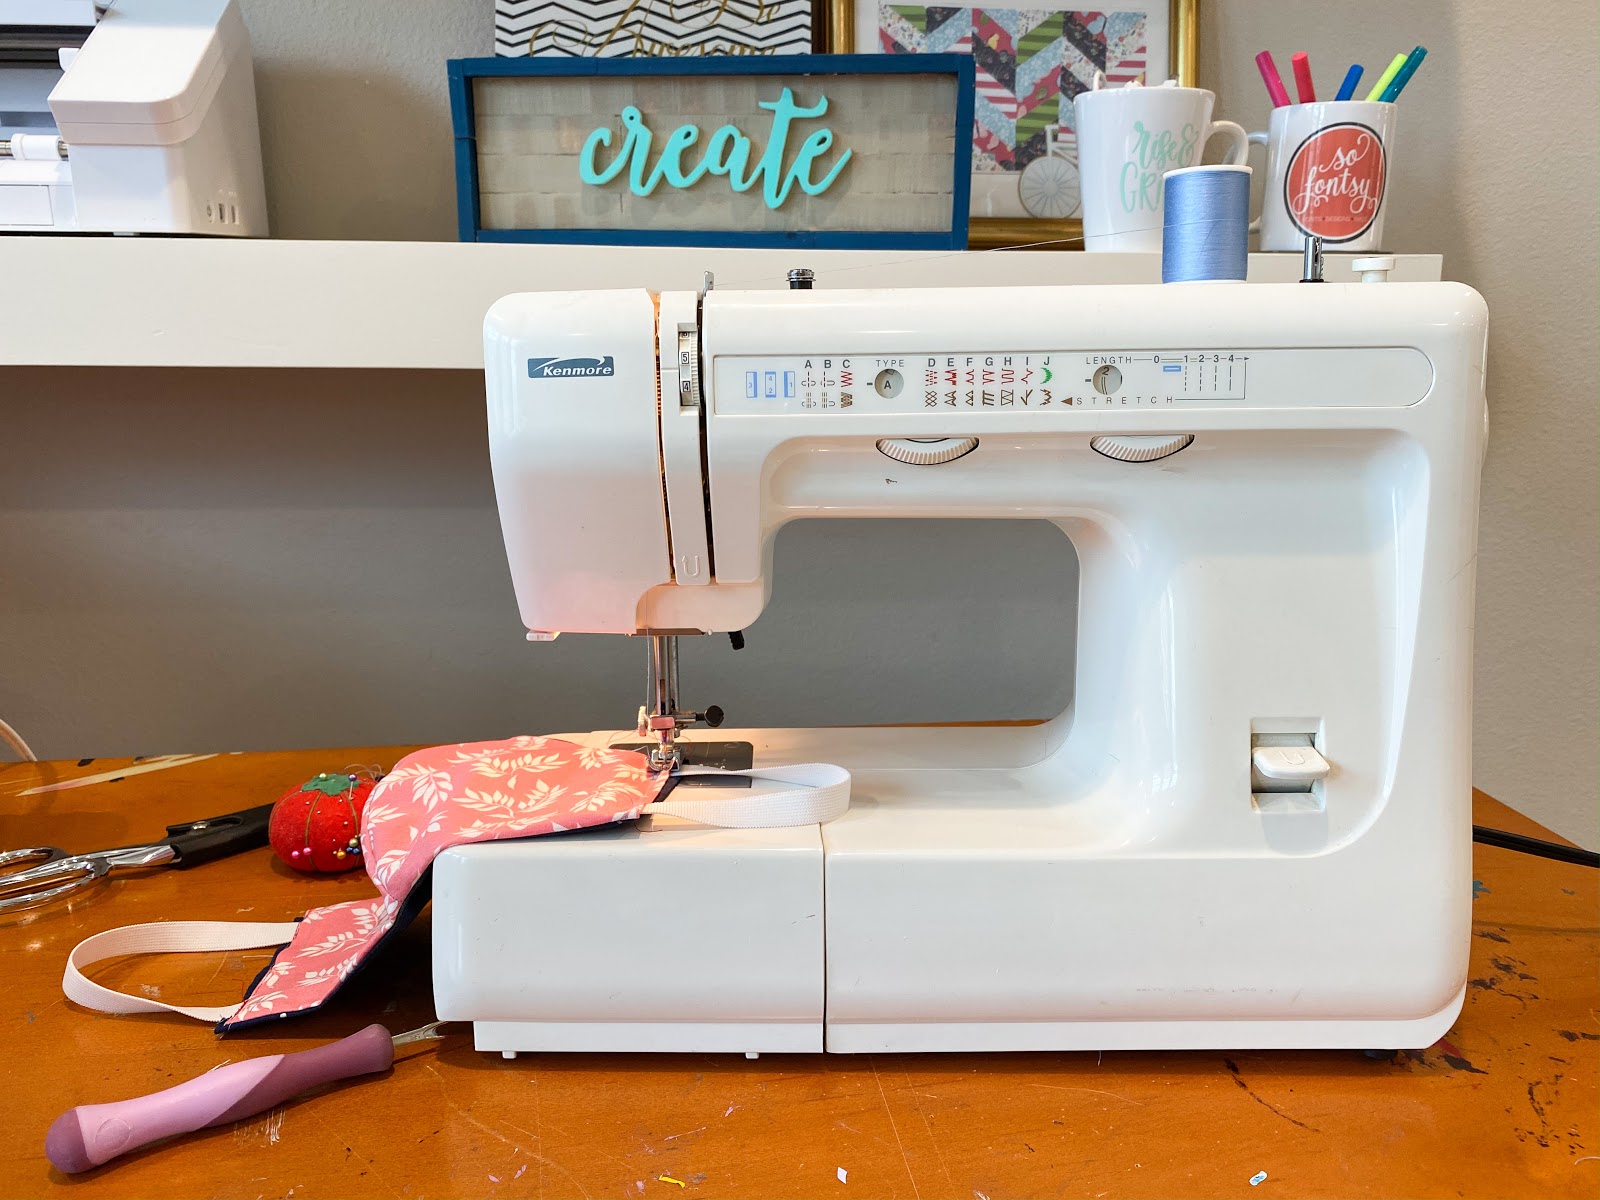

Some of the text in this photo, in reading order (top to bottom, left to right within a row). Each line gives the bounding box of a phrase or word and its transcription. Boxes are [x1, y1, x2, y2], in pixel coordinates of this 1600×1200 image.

[579, 87, 853, 210] create
[1319, 133, 1371, 174] so
[1120, 161, 1164, 213] GRI
[1293, 166, 1378, 215] fontsy
[804, 359, 851, 369] A B C
[875, 359, 905, 368] TYPE
[928, 358, 936, 367] D
[947, 357, 955, 367] E
[966, 357, 974, 367] F
[985, 356, 994, 366] G
[1004, 356, 1012, 366] H
[1043, 356, 1050, 366] J
[1085, 356, 1132, 365] LENGTH
[1153, 355, 1160, 364] 0
[1198, 354, 1205, 363] 2
[1213, 354, 1219, 363] 3
[1228, 354, 1234, 363] 4
[543, 365, 612, 377] Kenmore
[1102, 366, 1110, 376] 2
[883, 380, 892, 390] A
[1076, 396, 1173, 405] STRETCH
